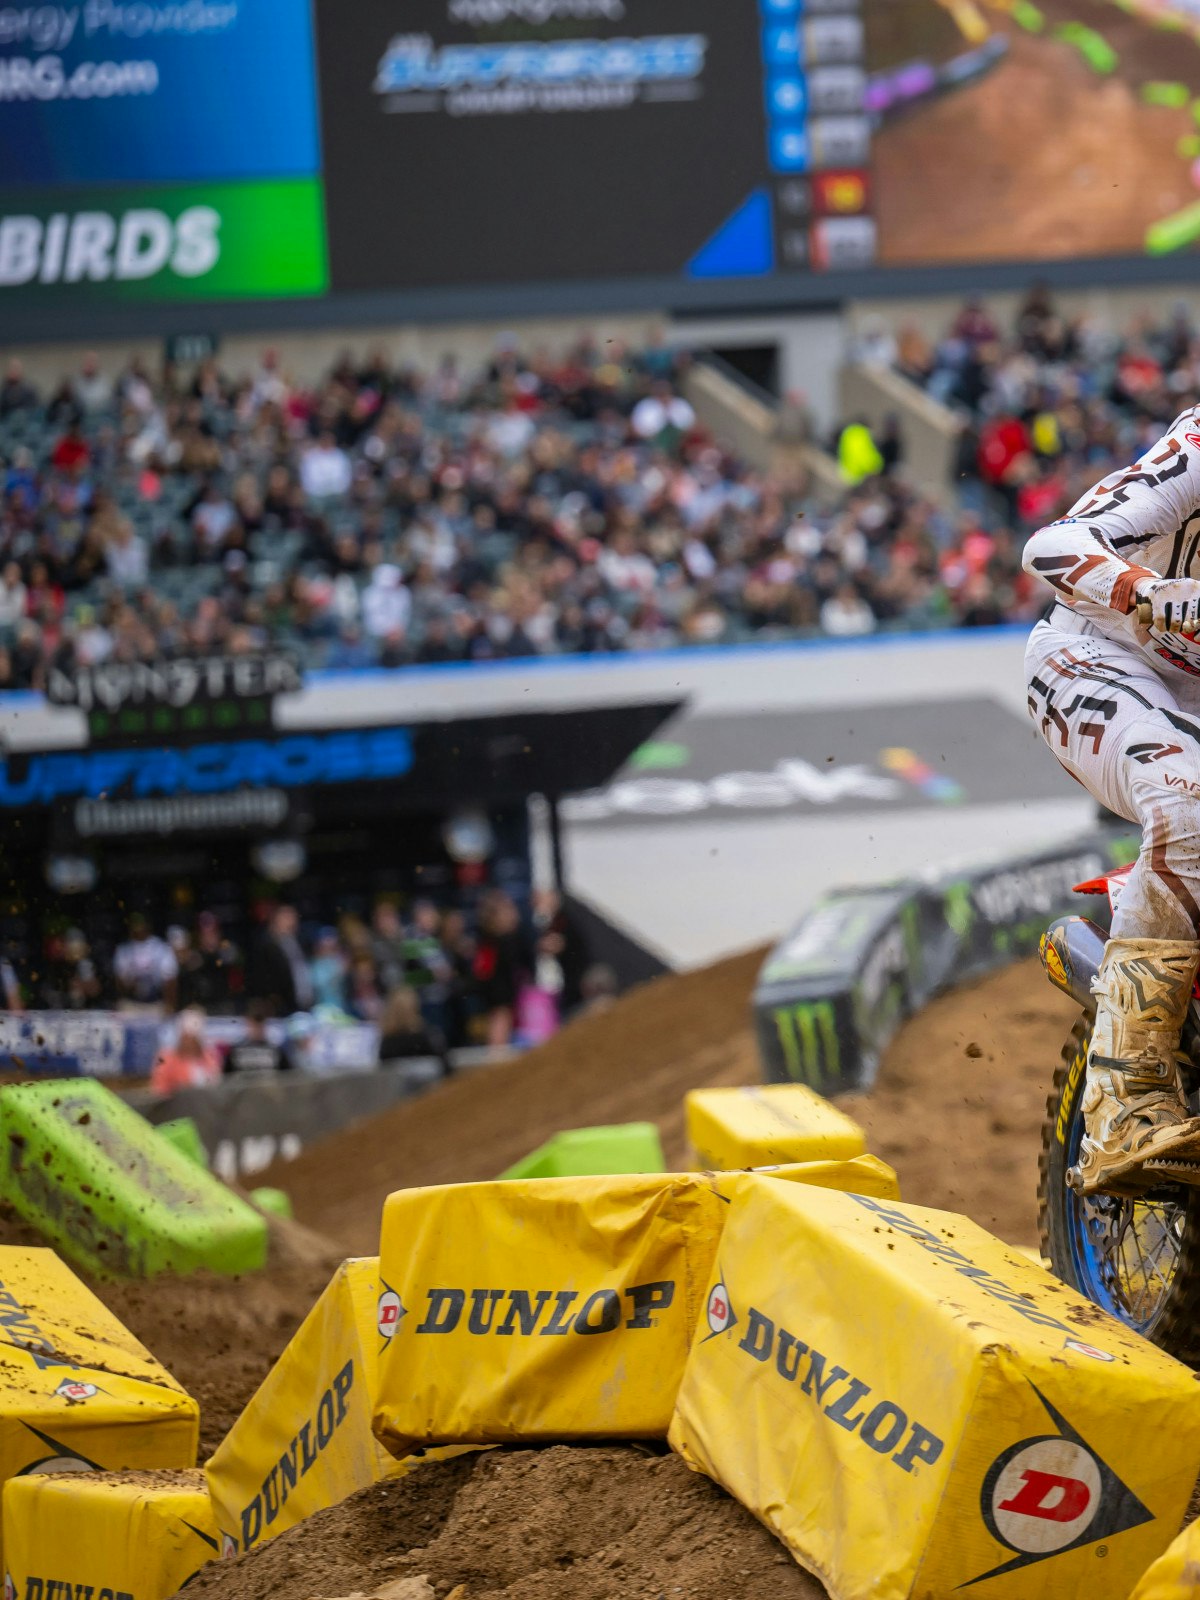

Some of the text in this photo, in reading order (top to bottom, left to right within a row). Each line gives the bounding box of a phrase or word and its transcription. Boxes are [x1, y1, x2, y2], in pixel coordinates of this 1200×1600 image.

[0, 205, 222, 286] BIRDS
[0, 726, 416, 806] UPERCROSS
[1056, 1028, 1094, 1147] PIREL
[416, 1280, 675, 1336] DUNLOP
[738, 1307, 944, 1474] DUNLOP
[241, 1359, 355, 1550] DUNLOP
[998, 1469, 1092, 1523] D
